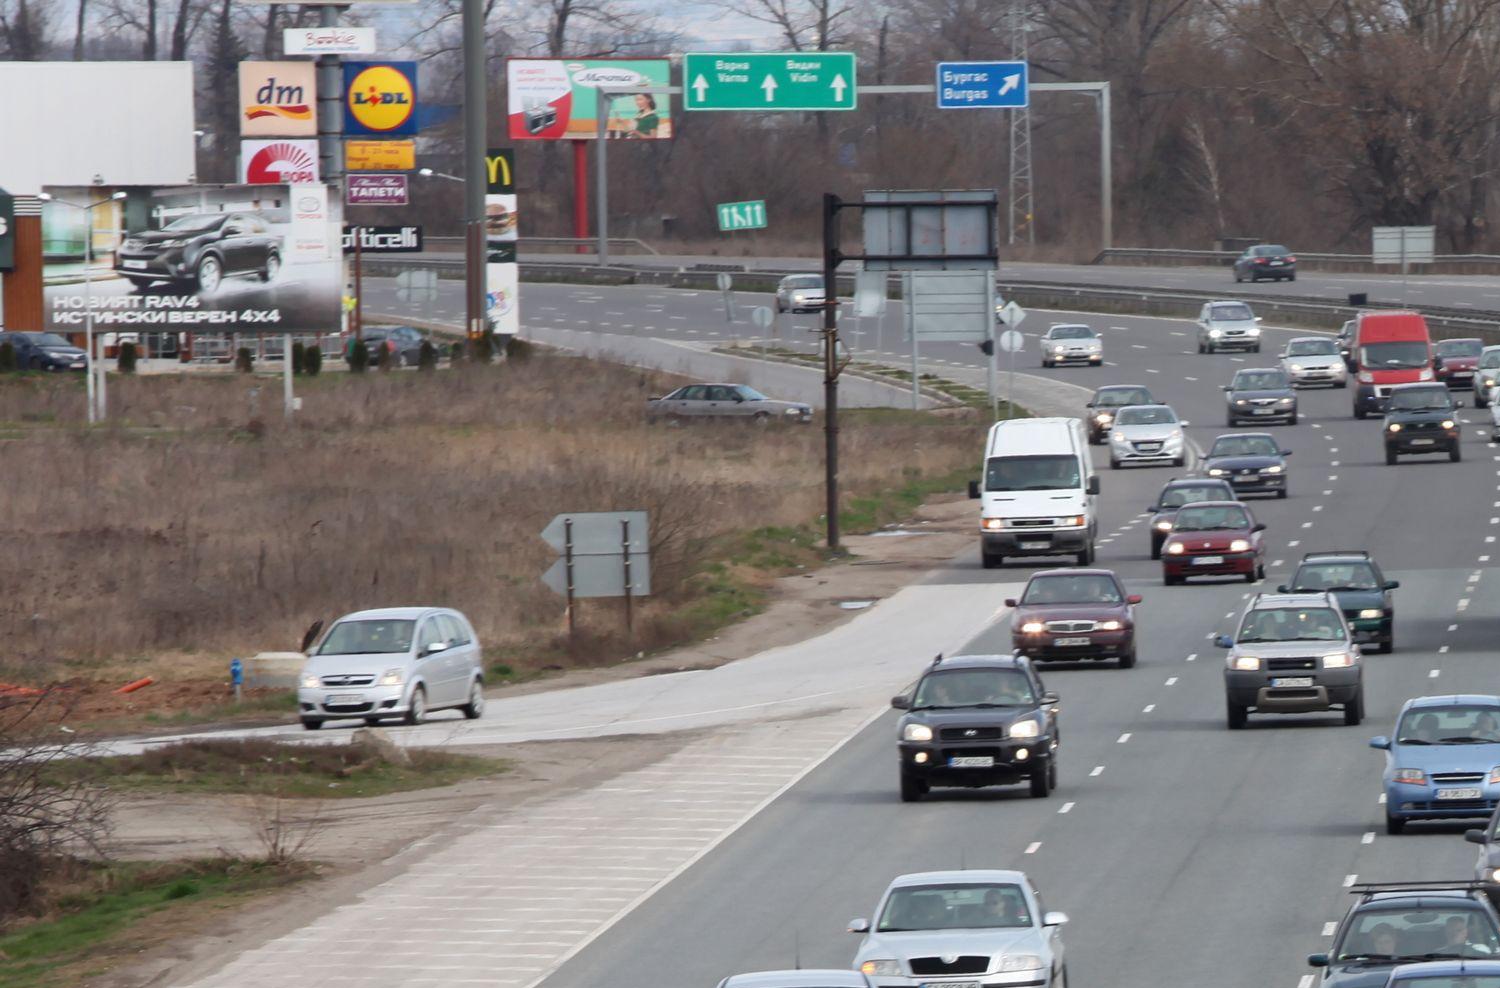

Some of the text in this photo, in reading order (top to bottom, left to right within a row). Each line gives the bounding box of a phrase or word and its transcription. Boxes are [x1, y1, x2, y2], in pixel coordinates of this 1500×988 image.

[715, 60, 749, 71] Варна
[786, 60, 821, 70] Видин
[718, 73, 748, 83] Varna
[790, 73, 817, 83] Vidin
[943, 71, 989, 85] Бургас
[257, 77, 304, 105] dm
[943, 88, 989, 102] Burgas
[350, 187, 406, 198] ТАПЕТИ
[340, 227, 418, 248] otticelli
[53, 296, 200, 308] НОВИЯТ RAV4
[52, 311, 166, 324] ИСТИНСКИ
[169, 311, 237, 323] ВЕРЕН
